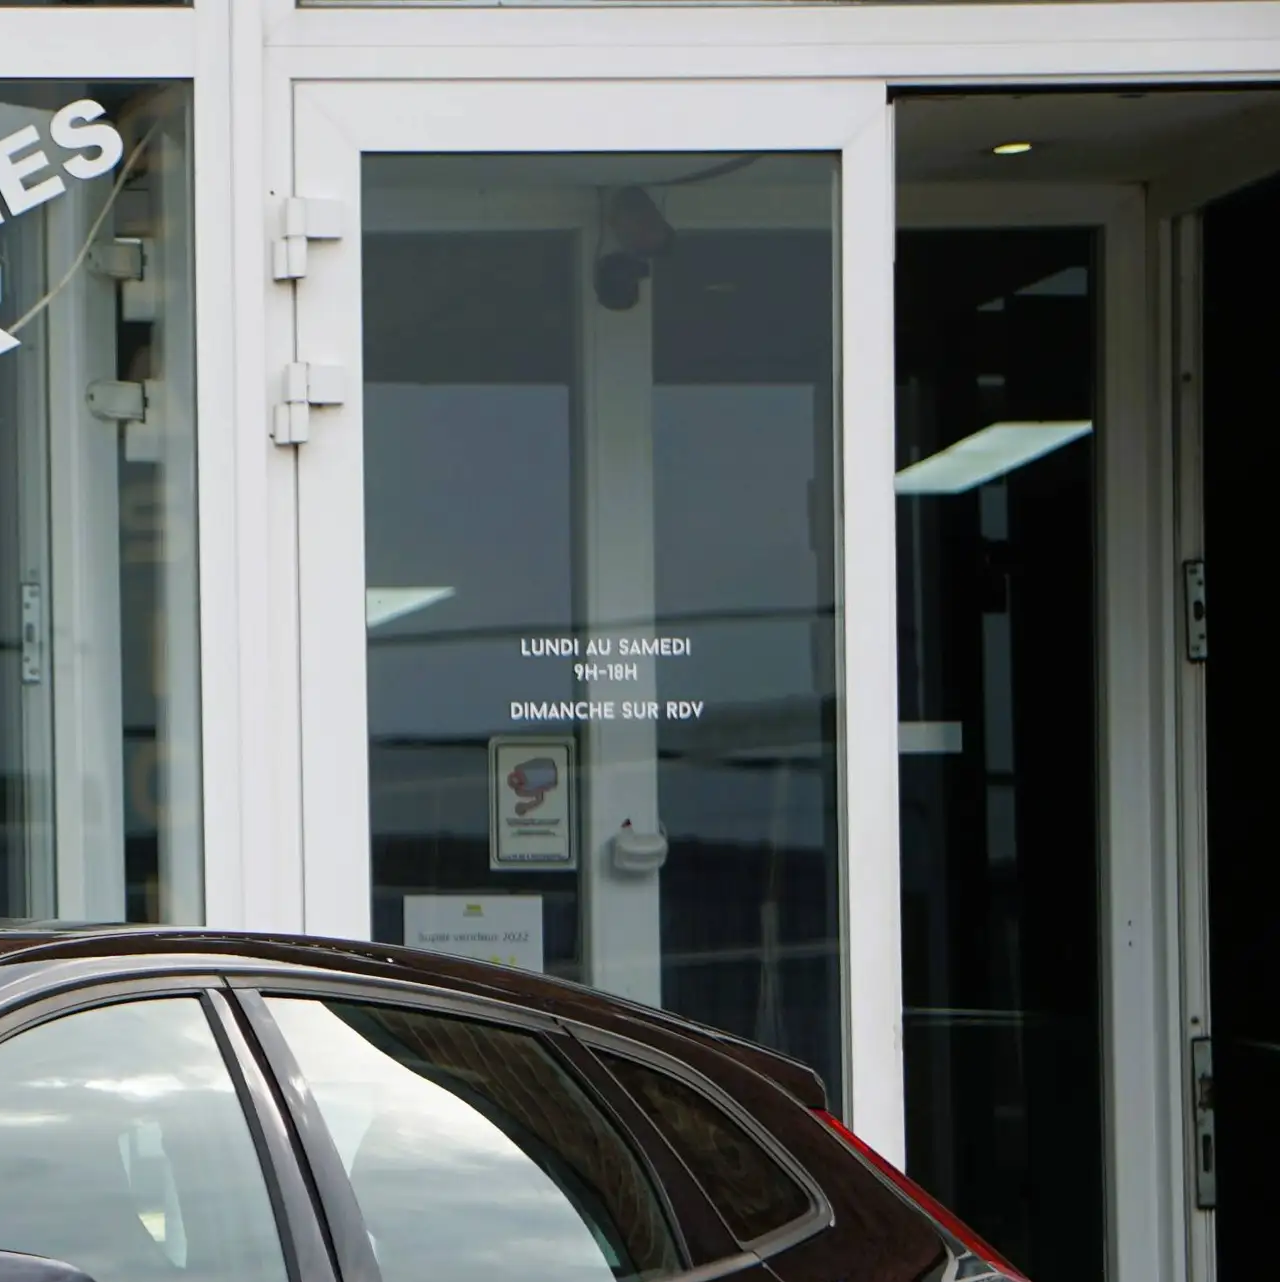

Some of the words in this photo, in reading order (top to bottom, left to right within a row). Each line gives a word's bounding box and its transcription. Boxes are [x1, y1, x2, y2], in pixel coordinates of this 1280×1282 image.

[520, 637, 580, 657] LUNDI
[586, 637, 611, 657] AU
[618, 637, 692, 657] SAMEDI
[573, 663, 638, 682] 9H-18H
[510, 701, 615, 720] DIMANCHE
[622, 701, 659, 720] SUR
[666, 701, 704, 720] RDV
